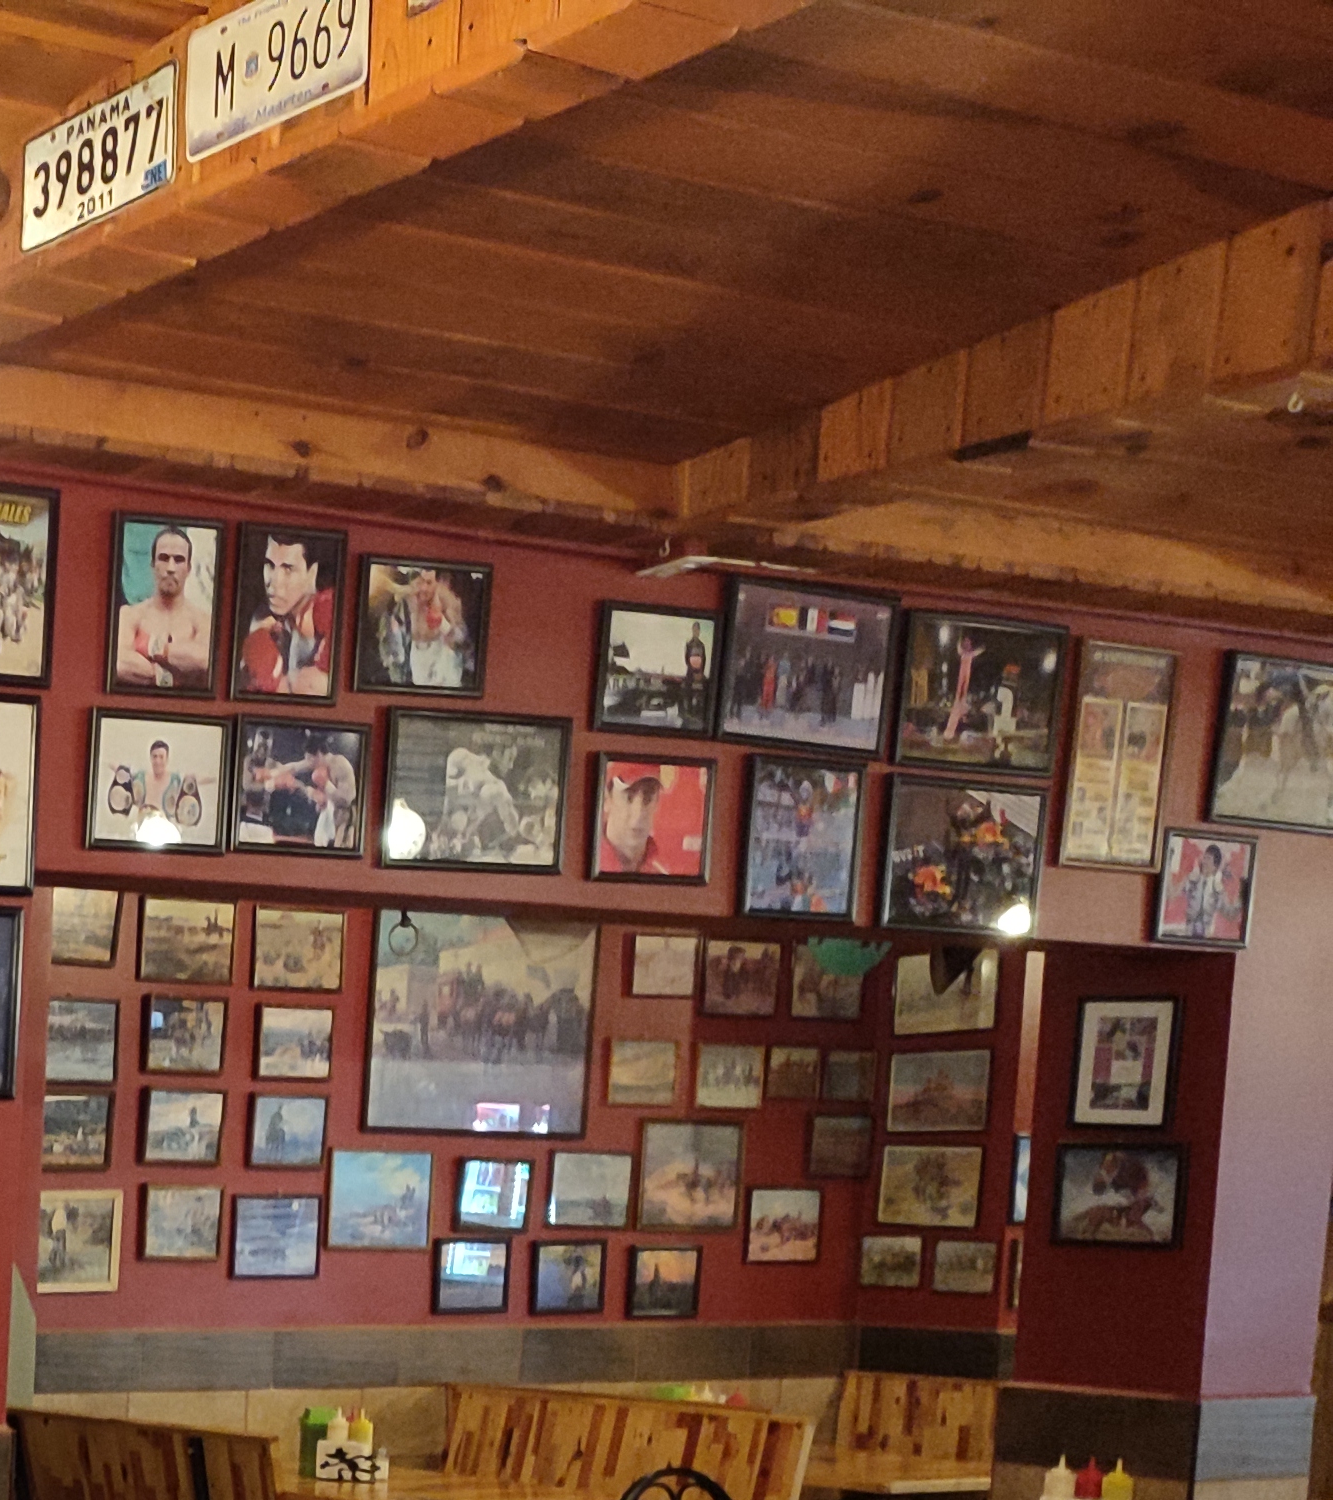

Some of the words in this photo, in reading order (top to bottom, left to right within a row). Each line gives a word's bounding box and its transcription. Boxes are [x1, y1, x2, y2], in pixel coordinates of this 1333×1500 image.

[214, 43, 236, 118] M
[268, 0, 356, 93] 9669
[32, 97, 165, 218] 398877
[66, 94, 131, 145] PANAMA
[76, 188, 113, 222] 2011
